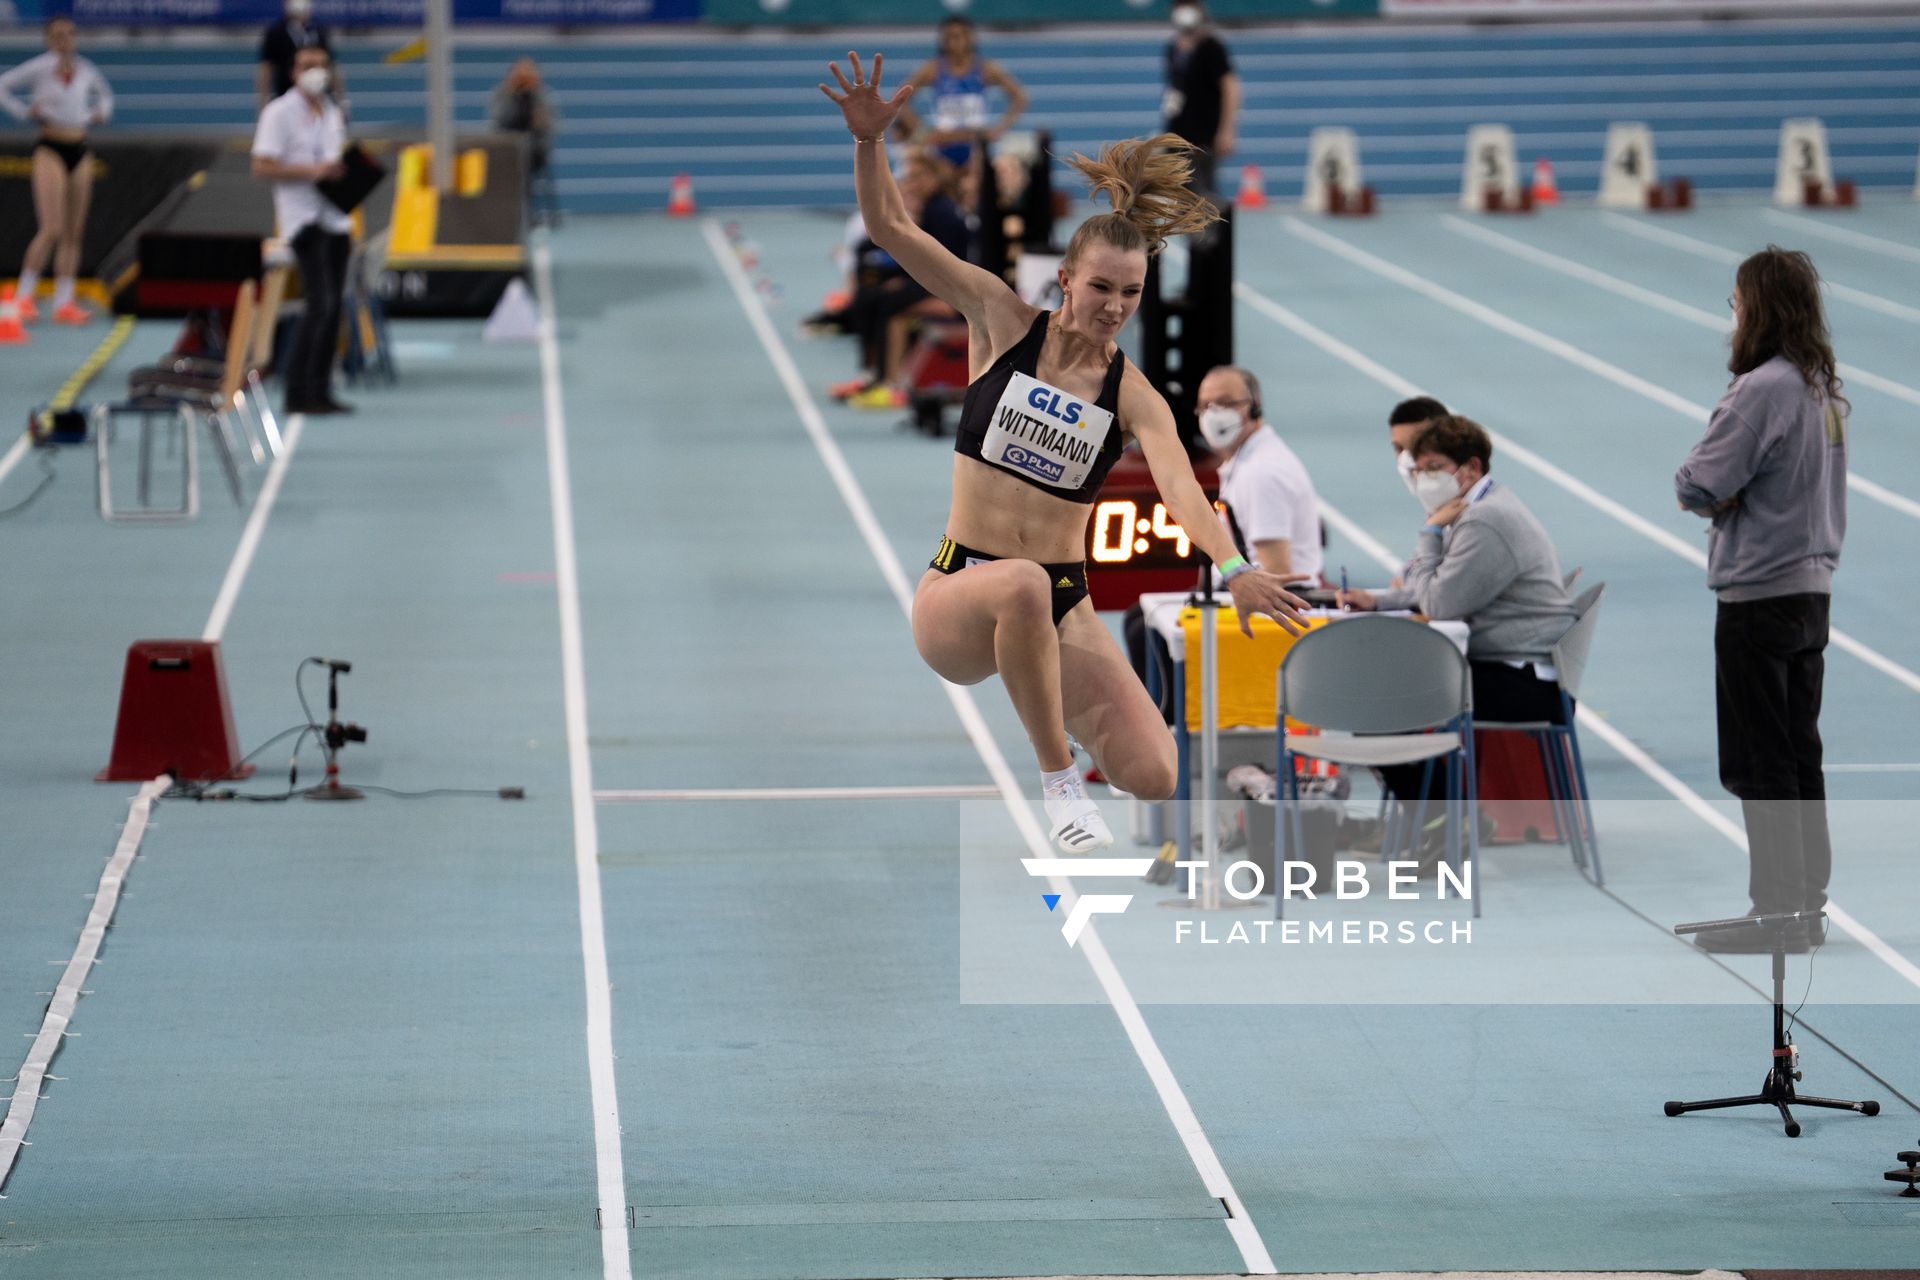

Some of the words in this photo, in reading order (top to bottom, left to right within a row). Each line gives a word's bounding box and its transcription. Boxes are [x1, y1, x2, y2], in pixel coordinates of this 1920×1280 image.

[1614, 141, 1642, 177] 4
[1791, 136, 1816, 173] 3
[998, 405, 1095, 465] WITTMANN
[1028, 455, 1061, 476] PLAN
